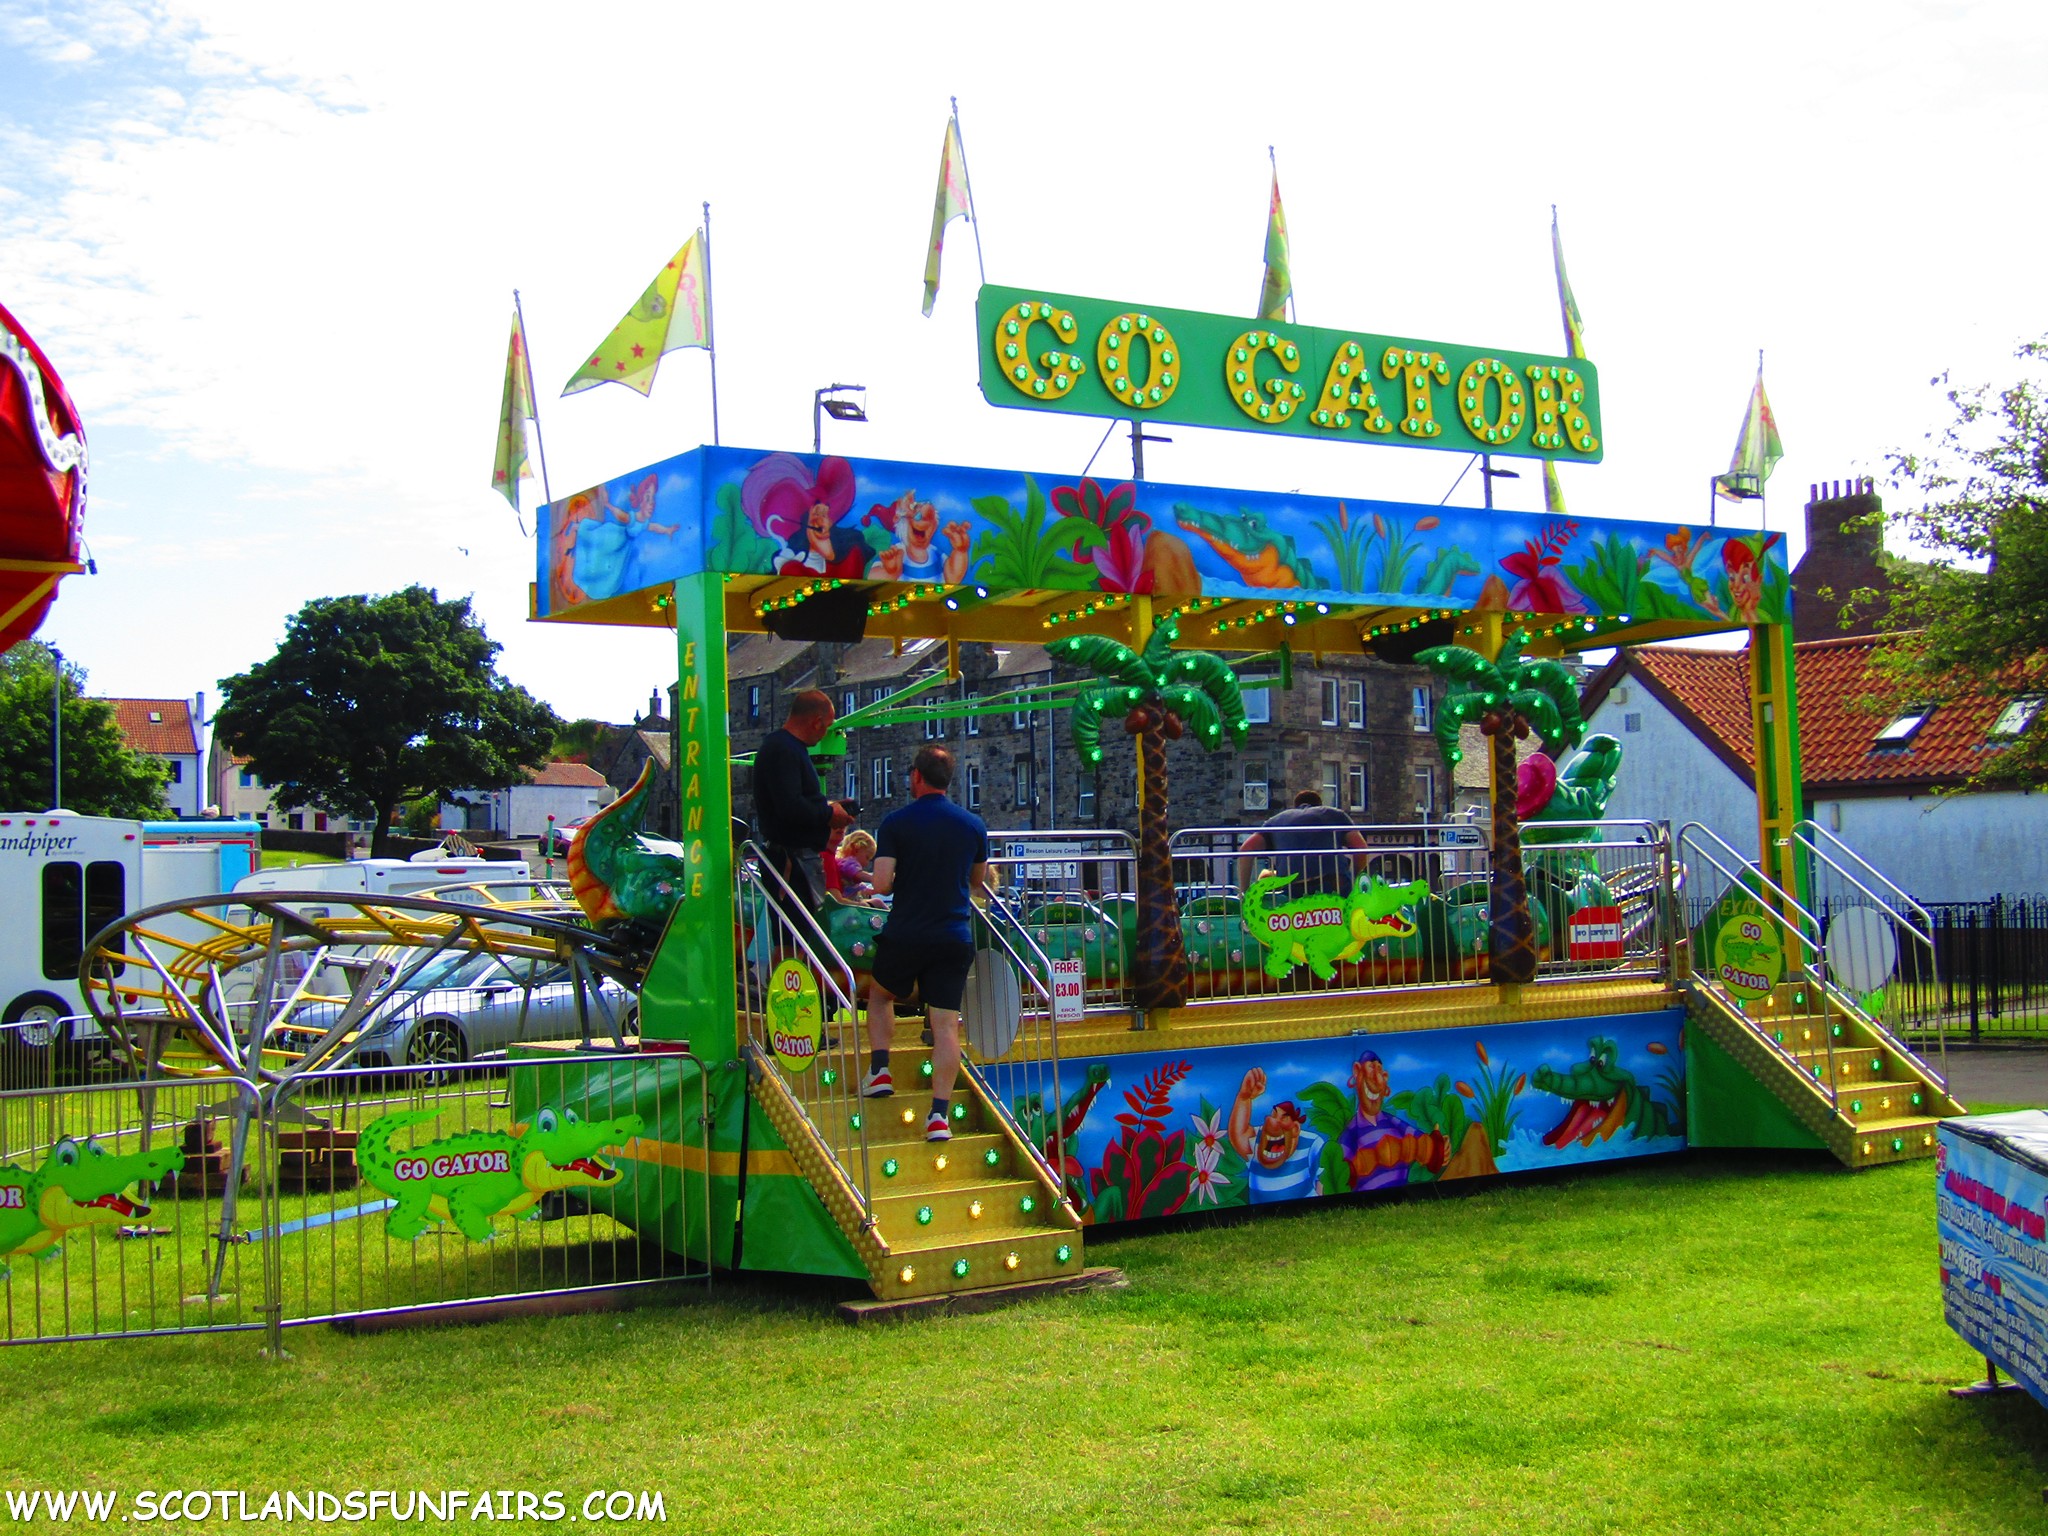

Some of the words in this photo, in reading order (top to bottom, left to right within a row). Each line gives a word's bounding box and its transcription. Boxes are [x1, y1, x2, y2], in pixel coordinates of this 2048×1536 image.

[996, 301, 1181, 409] GO
[1226, 330, 1599, 452] GATOR
[683, 642, 704, 897] ENTRANCE
[1720, 899, 1758, 916] EXIT
[1268, 914, 1291, 931] GO
[1292, 908, 1342, 930] GATOR
[1590, 928, 1614, 936] ENTRY
[1741, 922, 1761, 940] GO
[1054, 961, 1079, 974] FARE
[1720, 964, 1770, 990] GATOR
[784, 970, 801, 991] GO
[1055, 982, 1080, 997] £3.00
[774, 1030, 815, 1057] GATOR
[394, 1157, 430, 1181] GO
[432, 1149, 510, 1178] GATOR
